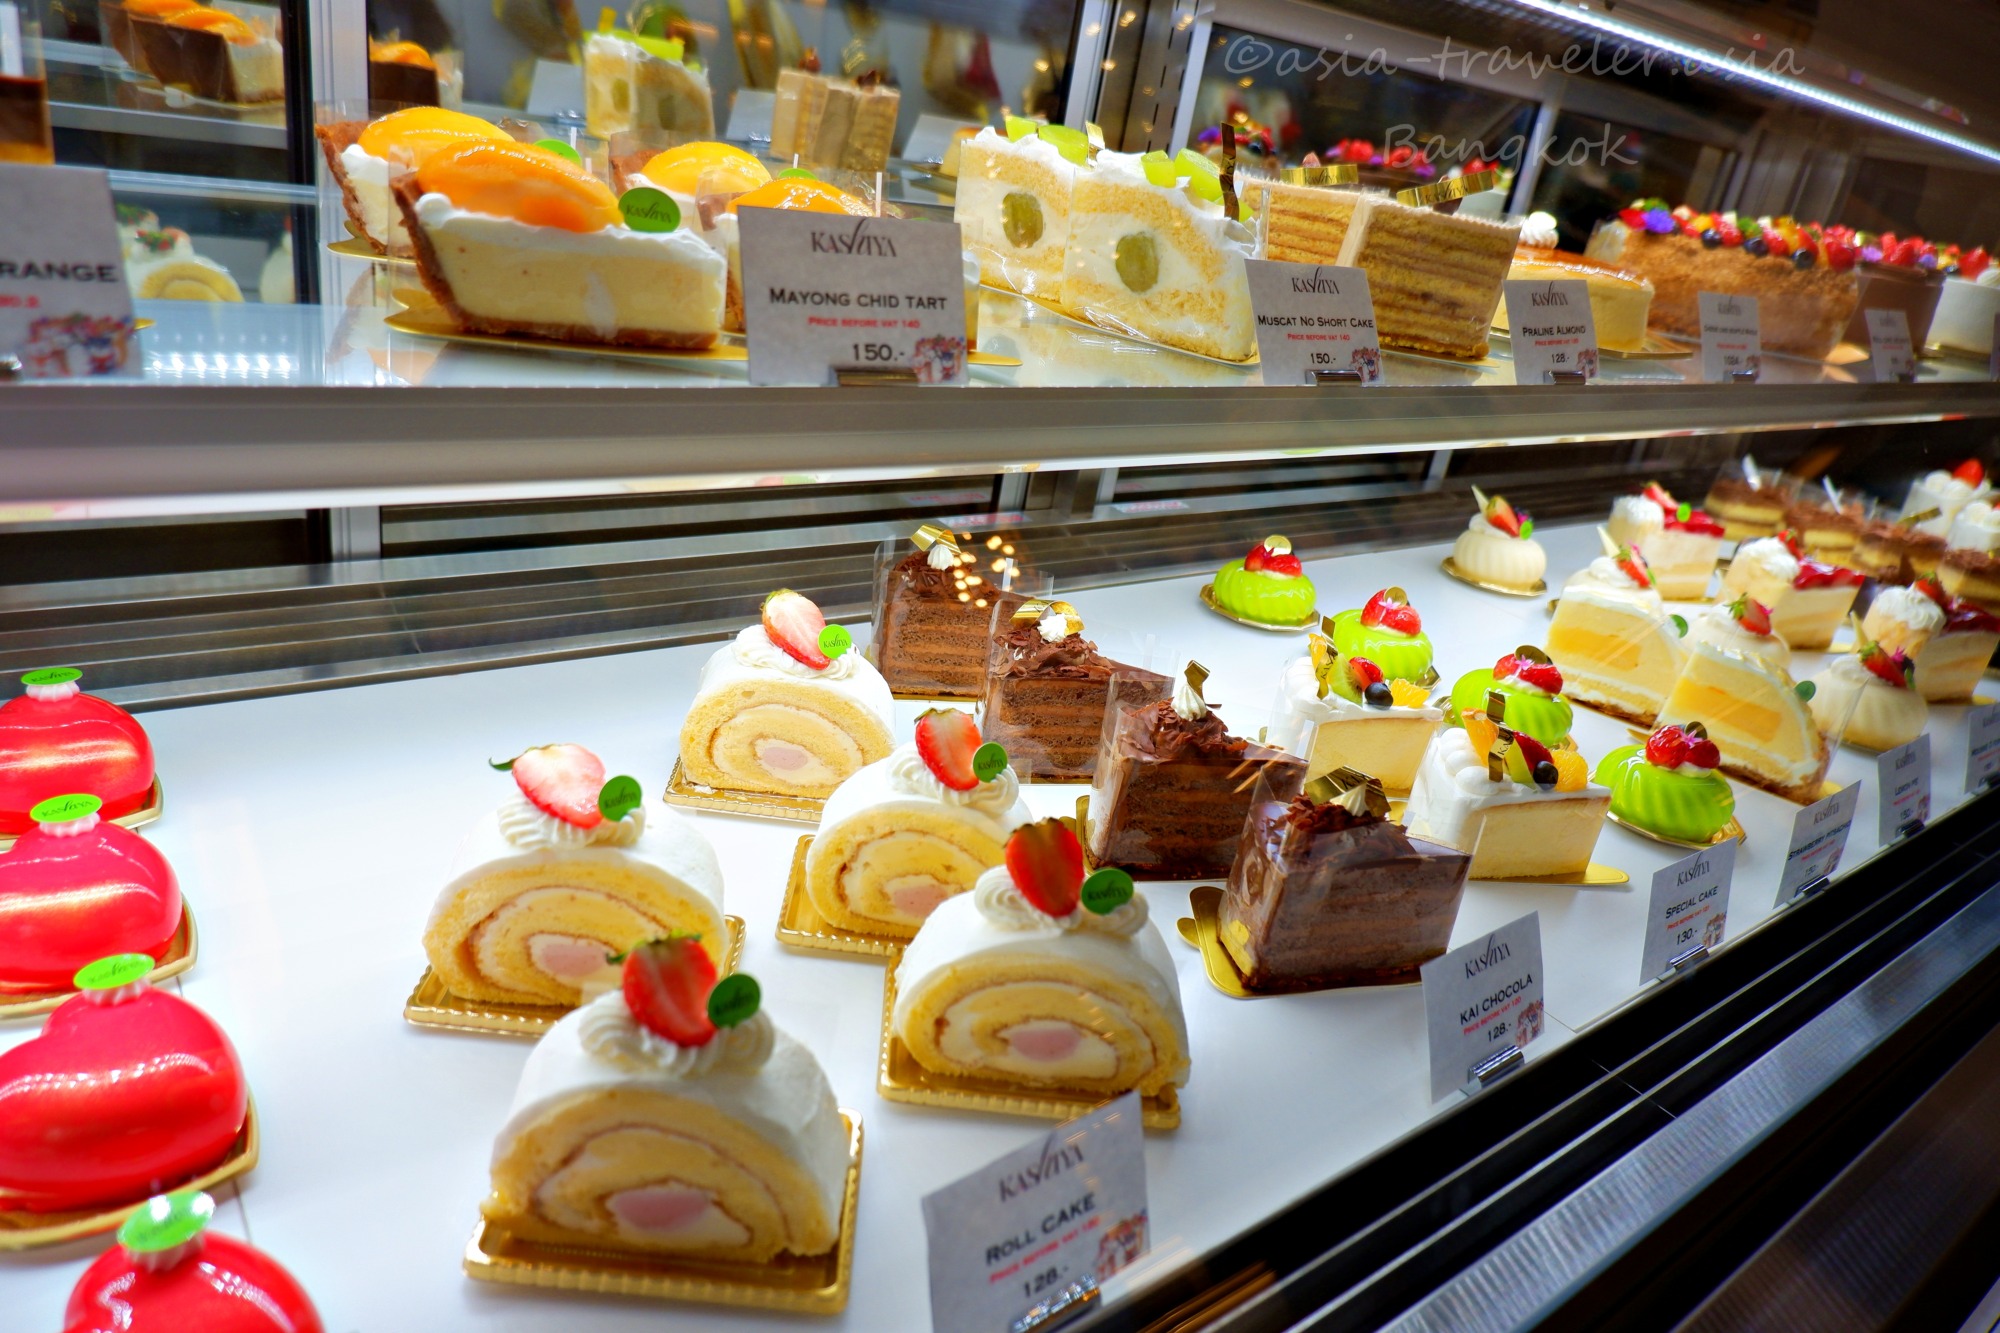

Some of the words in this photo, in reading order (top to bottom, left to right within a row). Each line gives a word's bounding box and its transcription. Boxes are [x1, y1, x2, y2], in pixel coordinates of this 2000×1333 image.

[769, 288, 850, 307] MAYONG
[857, 294, 900, 308] CHID
[905, 296, 947, 310] TART
[808, 316, 838, 327] PRICE
[841, 318, 878, 328] BEFORE
[881, 319, 898, 328] VAT
[902, 319, 920, 329] 140
[1257, 315, 1297, 326] MUSCAT
[1300, 316, 1315, 327] NO
[1317, 317, 1347, 327] SHORT
[1350, 318, 1374, 328] CAKE
[1522, 326, 1554, 337] PRALINE
[1557, 325, 1586, 336] ALMOND
[853, 343, 905, 361] 150.-
[1310, 353, 1337, 364] 150.-
[1665, 898, 1697, 919] SPECIAL
[1698, 886, 1719, 903] CAKE
[1460, 1008, 1479, 1025] KAI
[1482, 974, 1533, 1011] CHOCOLA
[986, 1229, 1036, 1266] ROLL
[1040, 1192, 1095, 1234] CAKE
